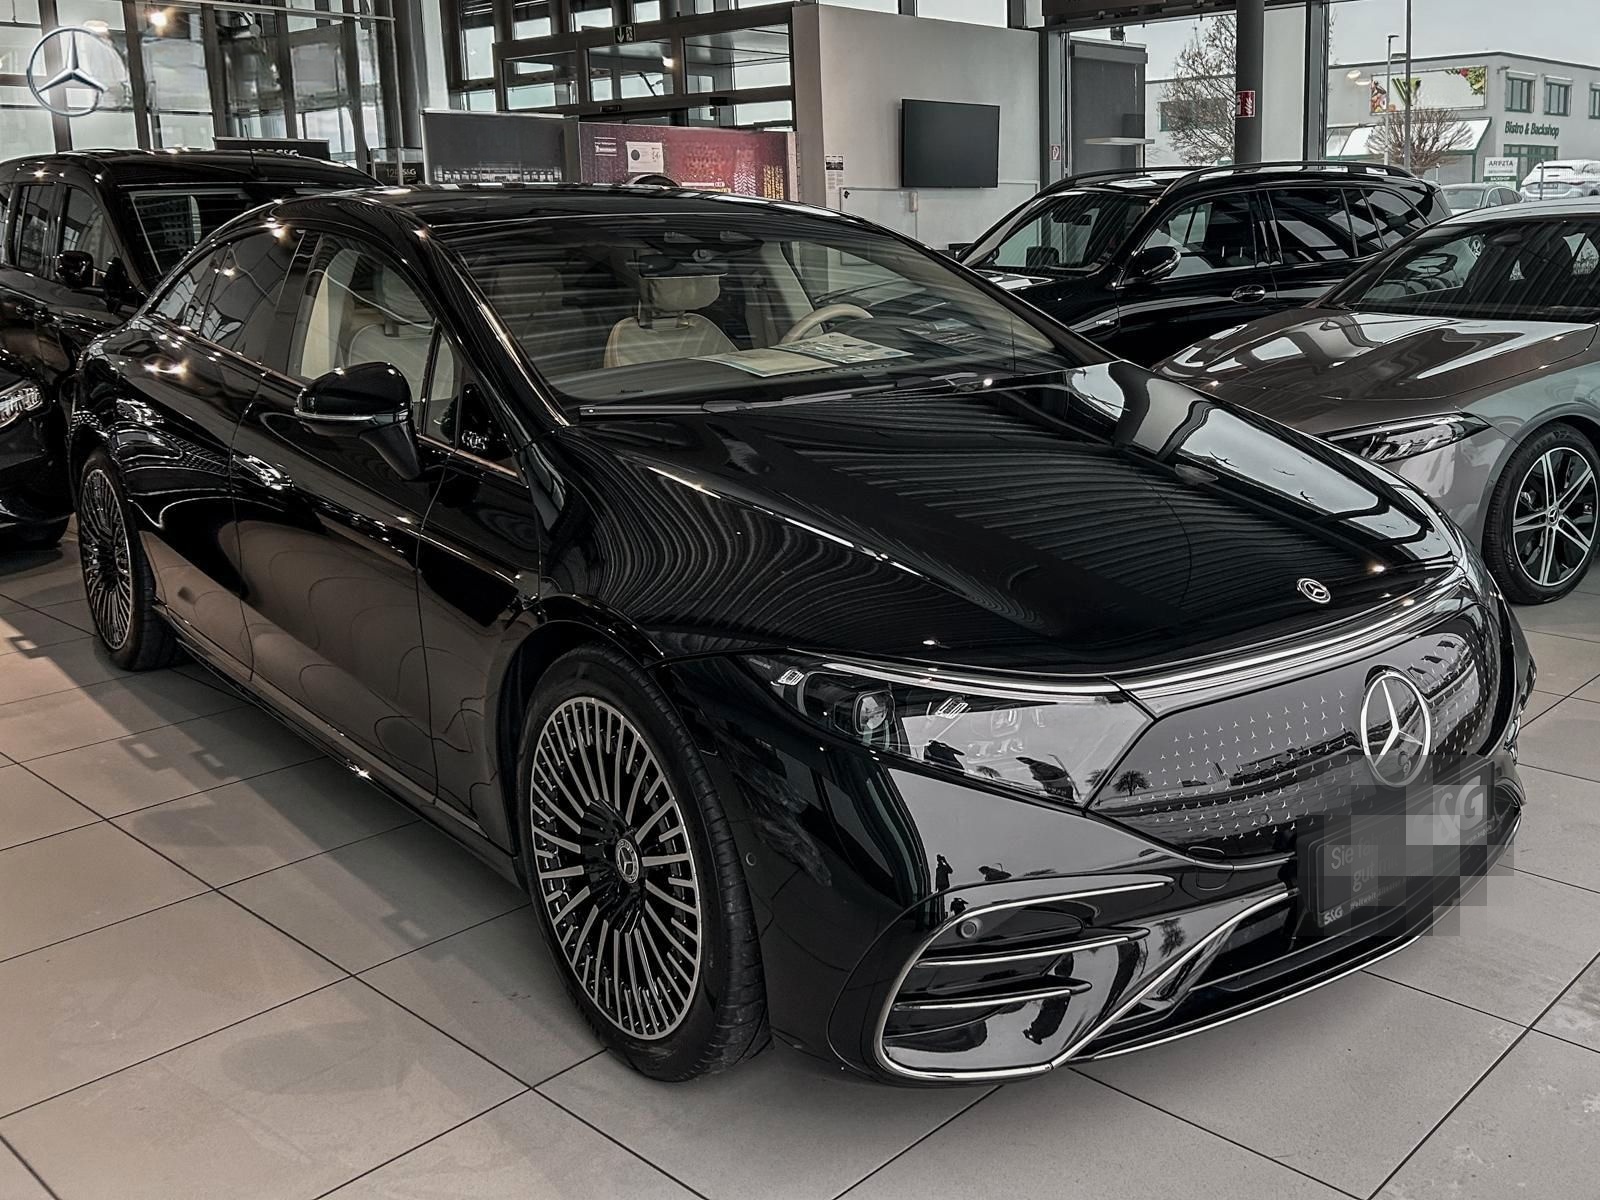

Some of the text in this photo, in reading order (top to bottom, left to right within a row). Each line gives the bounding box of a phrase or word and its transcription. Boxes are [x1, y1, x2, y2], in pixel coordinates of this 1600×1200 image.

[1505, 121, 1559, 139] Bistro & Backshop
[1331, 845, 1354, 869] Sie
[1352, 861, 1375, 892] gut
